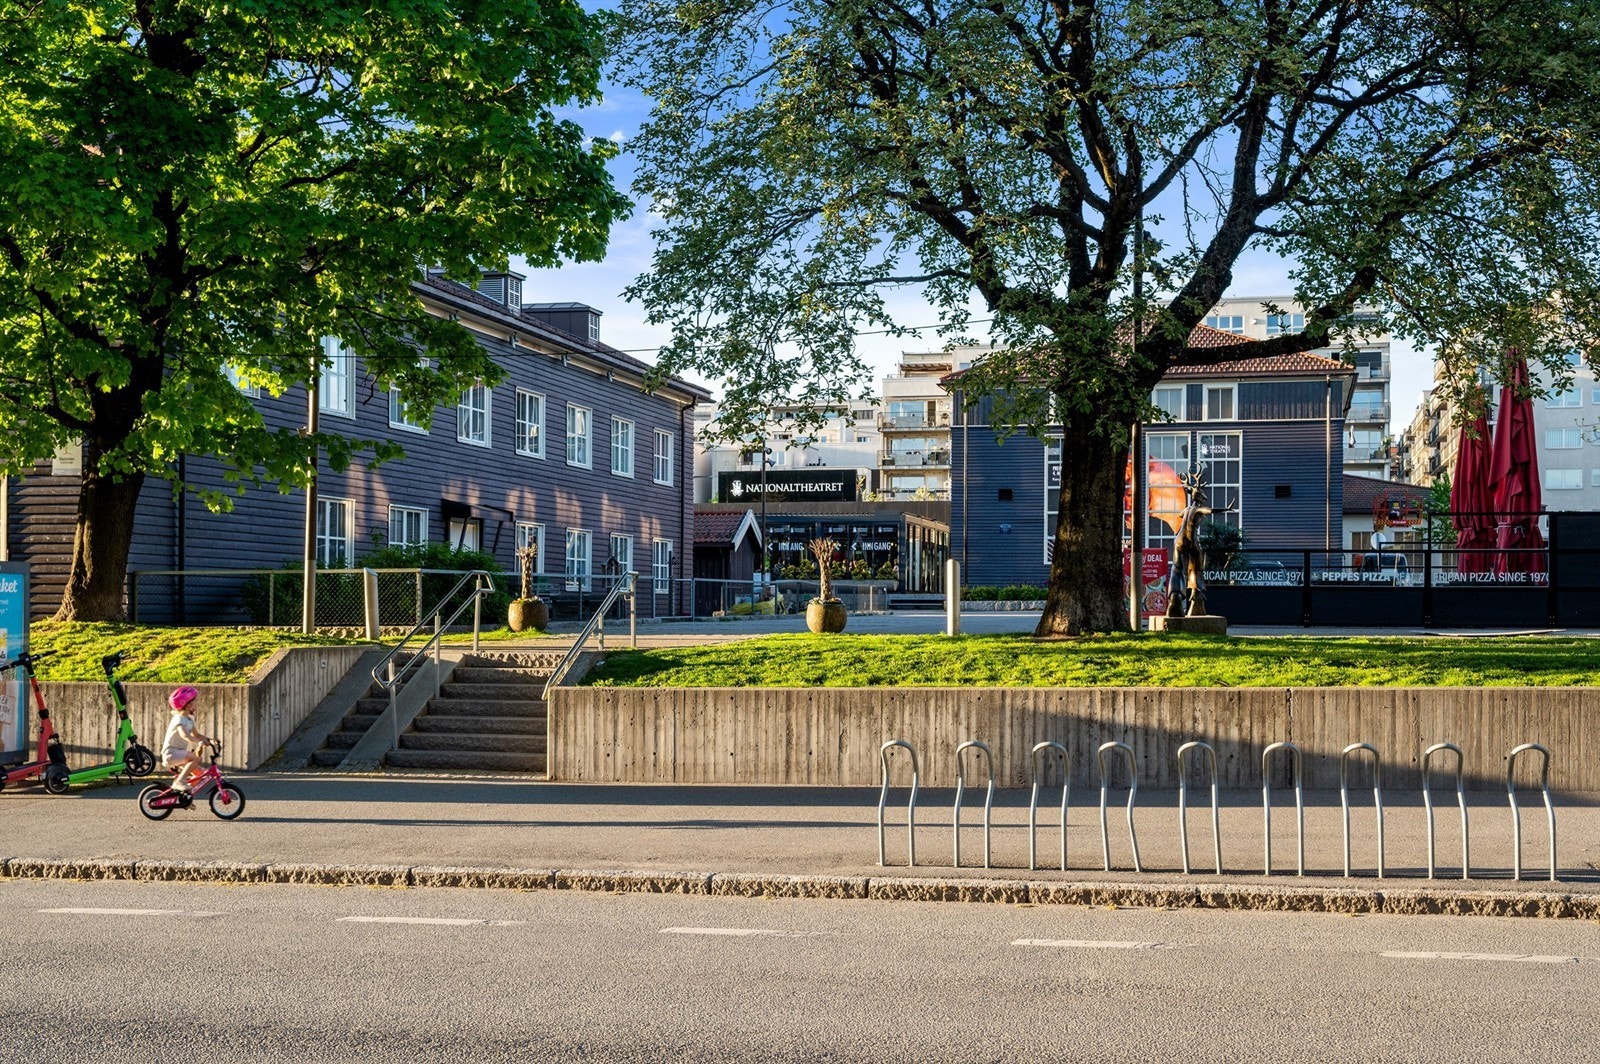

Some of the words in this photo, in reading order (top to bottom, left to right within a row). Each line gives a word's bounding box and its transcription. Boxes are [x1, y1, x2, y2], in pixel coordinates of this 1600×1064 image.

[745, 482, 843, 493] NATIONALTHEATRET
[1147, 554, 1163, 562] DEAL
[1203, 571, 1227, 581] RICAN
[1229, 571, 1255, 581] PIZZA
[1256, 571, 1284, 581] SINCE
[1322, 572, 1360, 581] PEPPES
[1362, 572, 1391, 582] PIZZA
[1469, 572, 1496, 582] PIZZA
[1498, 572, 1527, 582] SINCE
